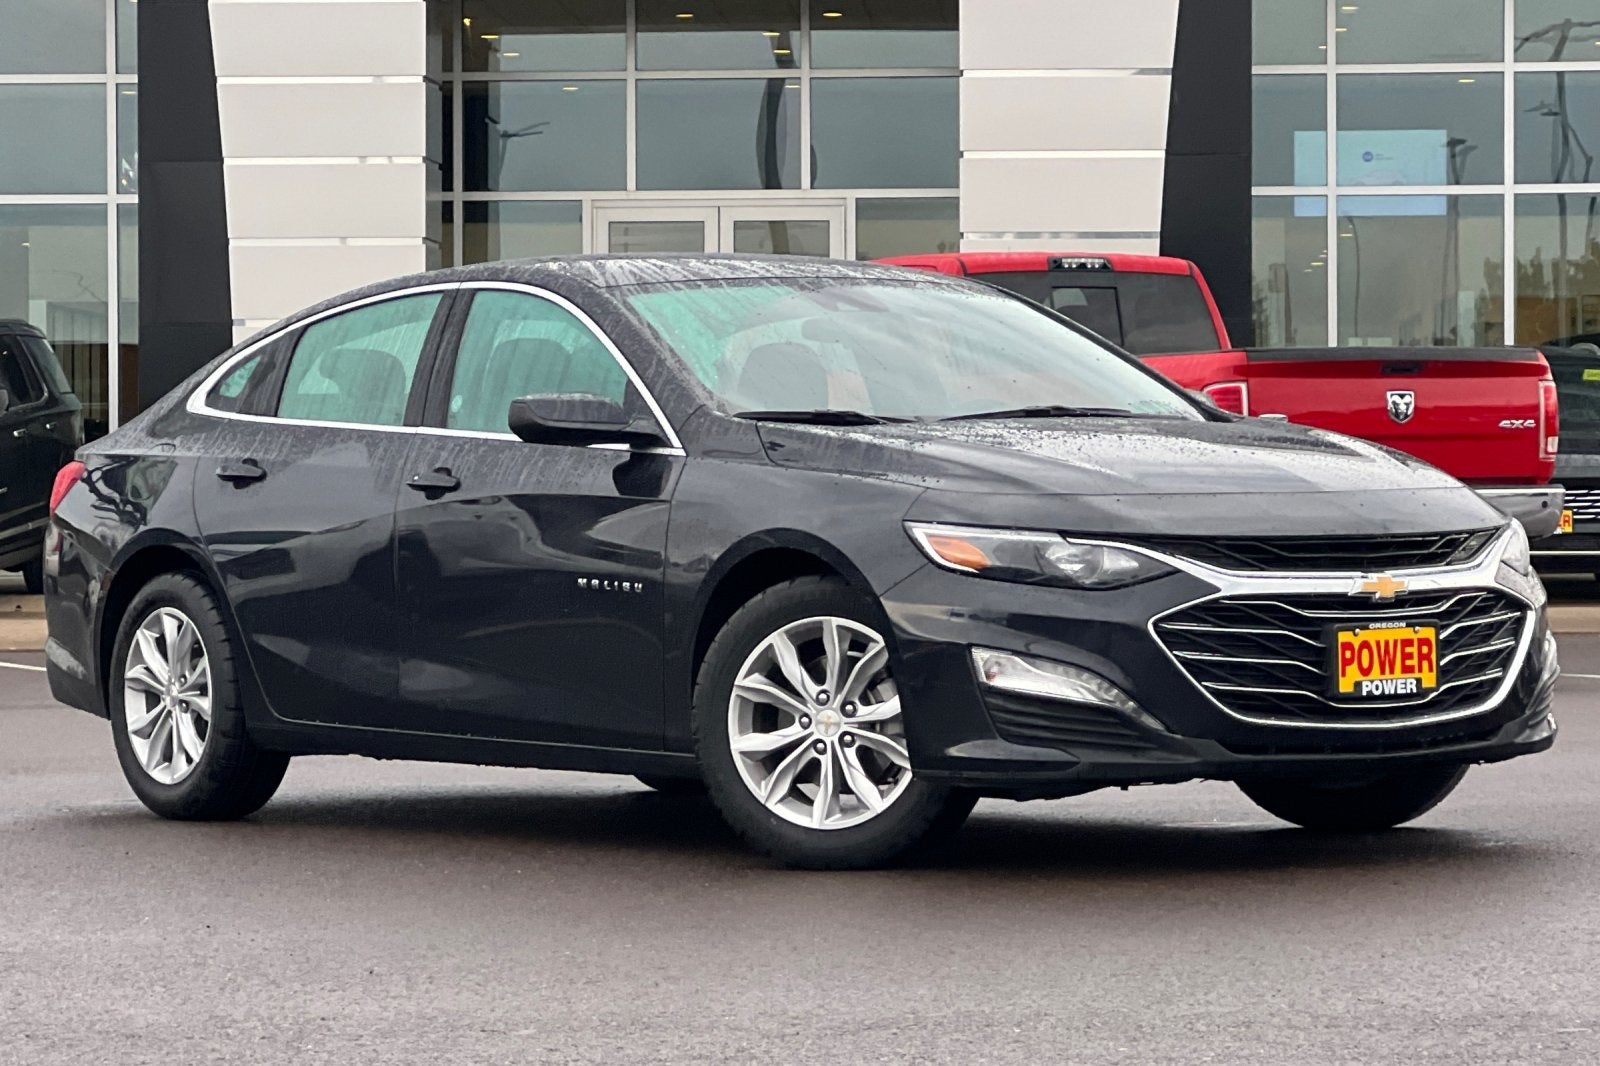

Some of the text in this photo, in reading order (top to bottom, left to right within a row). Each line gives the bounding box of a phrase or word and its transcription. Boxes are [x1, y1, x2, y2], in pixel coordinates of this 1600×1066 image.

[577, 578, 643, 592] MALIBU
[1340, 637, 1434, 678] POWER
[1361, 678, 1417, 696] POWER
